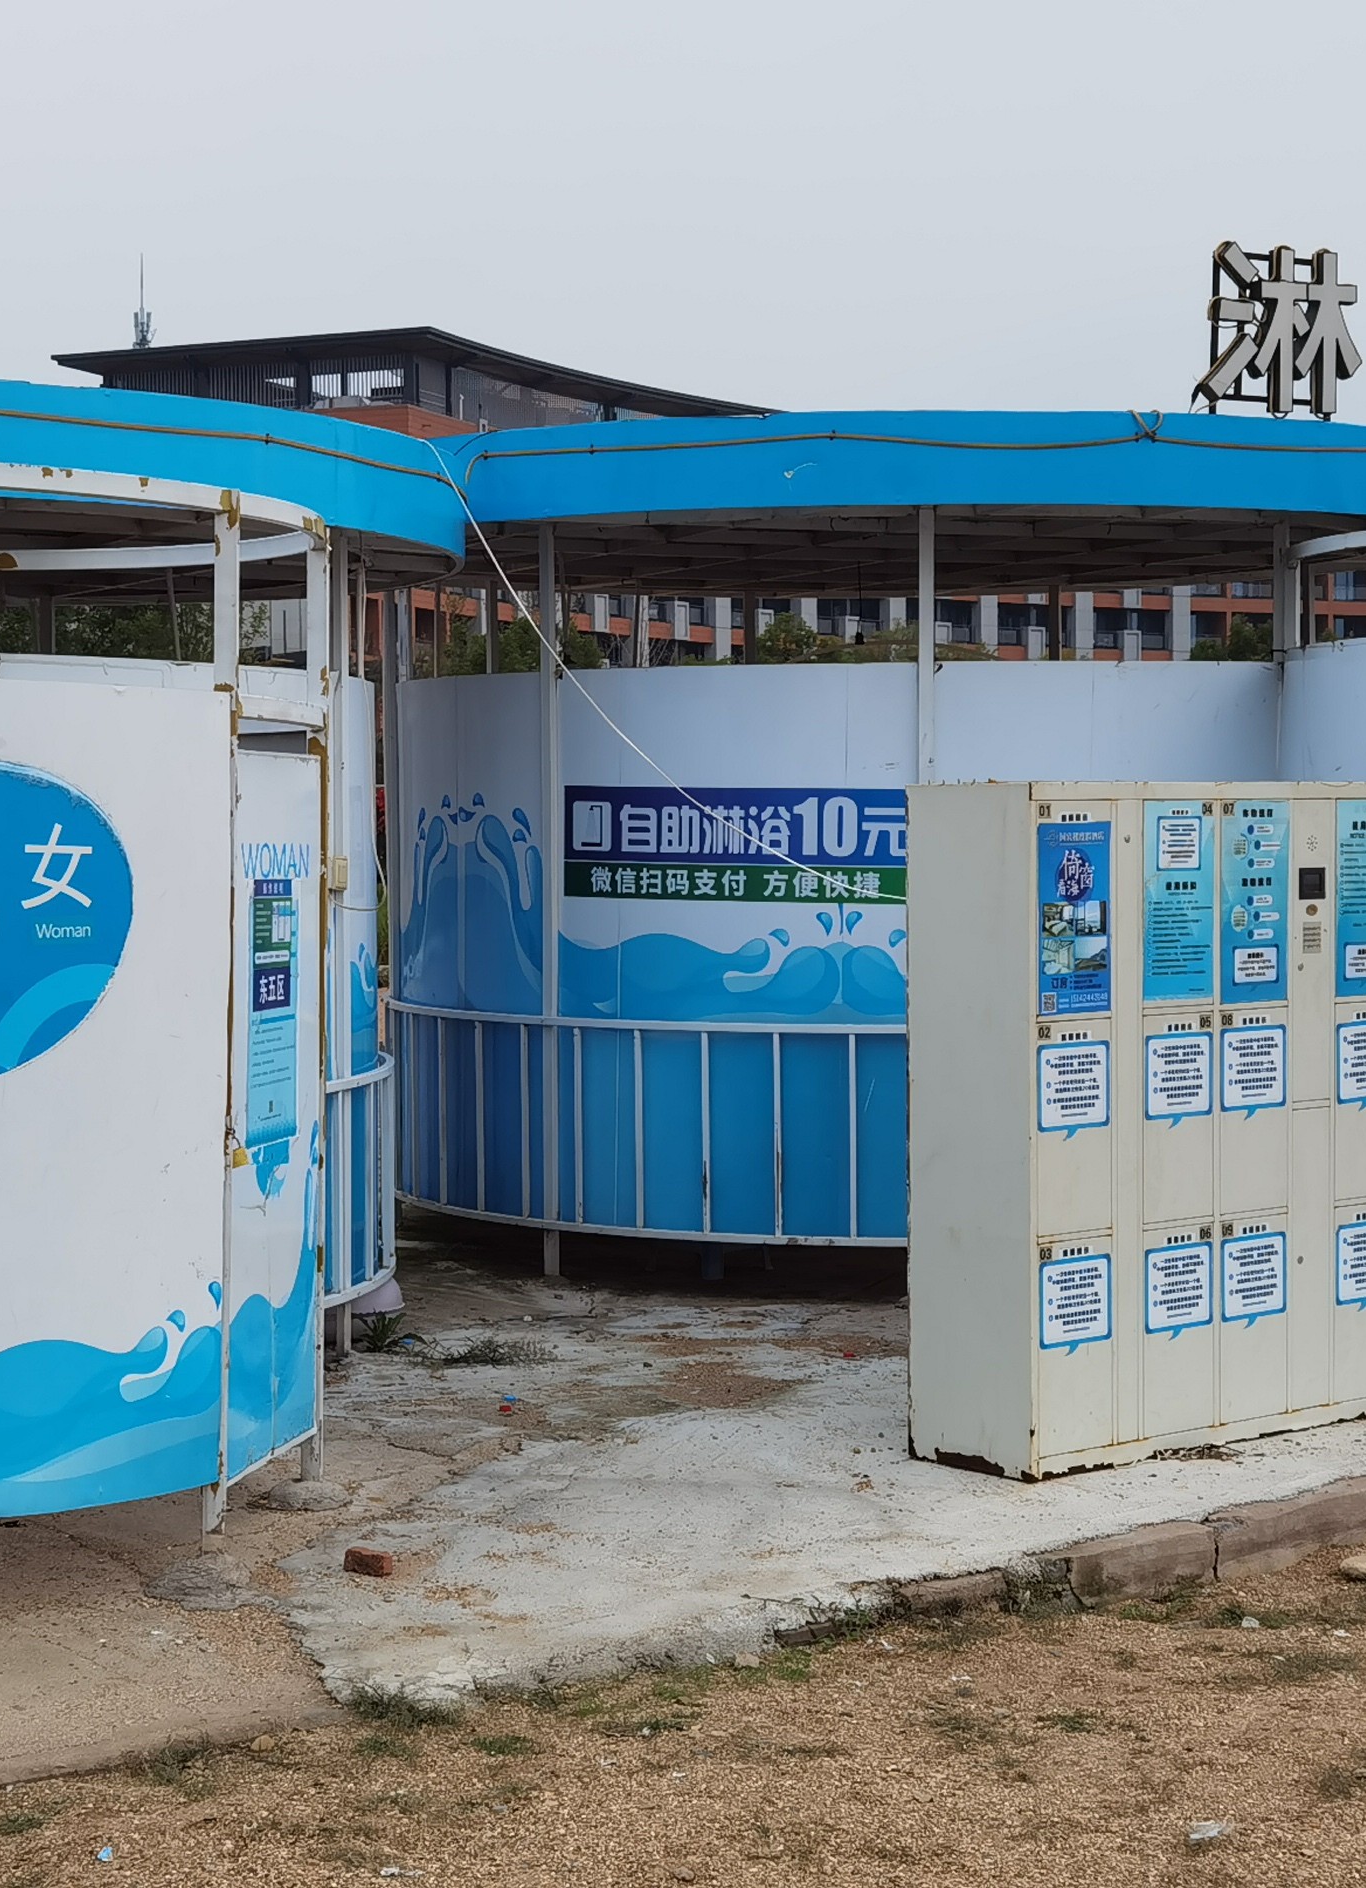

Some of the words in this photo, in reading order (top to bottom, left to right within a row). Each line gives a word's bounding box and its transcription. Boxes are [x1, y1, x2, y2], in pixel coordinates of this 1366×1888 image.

[1039, 805, 1051, 817] 01
[1202, 803, 1213, 815] 04
[1223, 803, 1234, 815] 07
[619, 796, 906, 857] 自助淋浴10元
[21, 823, 93, 909] 女
[241, 843, 310, 878] WOMAN
[590, 867, 747, 897] 微信扫码支付
[763, 871, 881, 899] 方便快捷
[35, 923, 92, 938] Woman
[259, 974, 285, 1004] 东五区
[1200, 1017, 1211, 1028] 05
[1221, 1014, 1233, 1026] 08
[1038, 1027, 1051, 1039] 02
[1200, 1228, 1211, 1239] 06
[1040, 1248, 1052, 1260] 03
